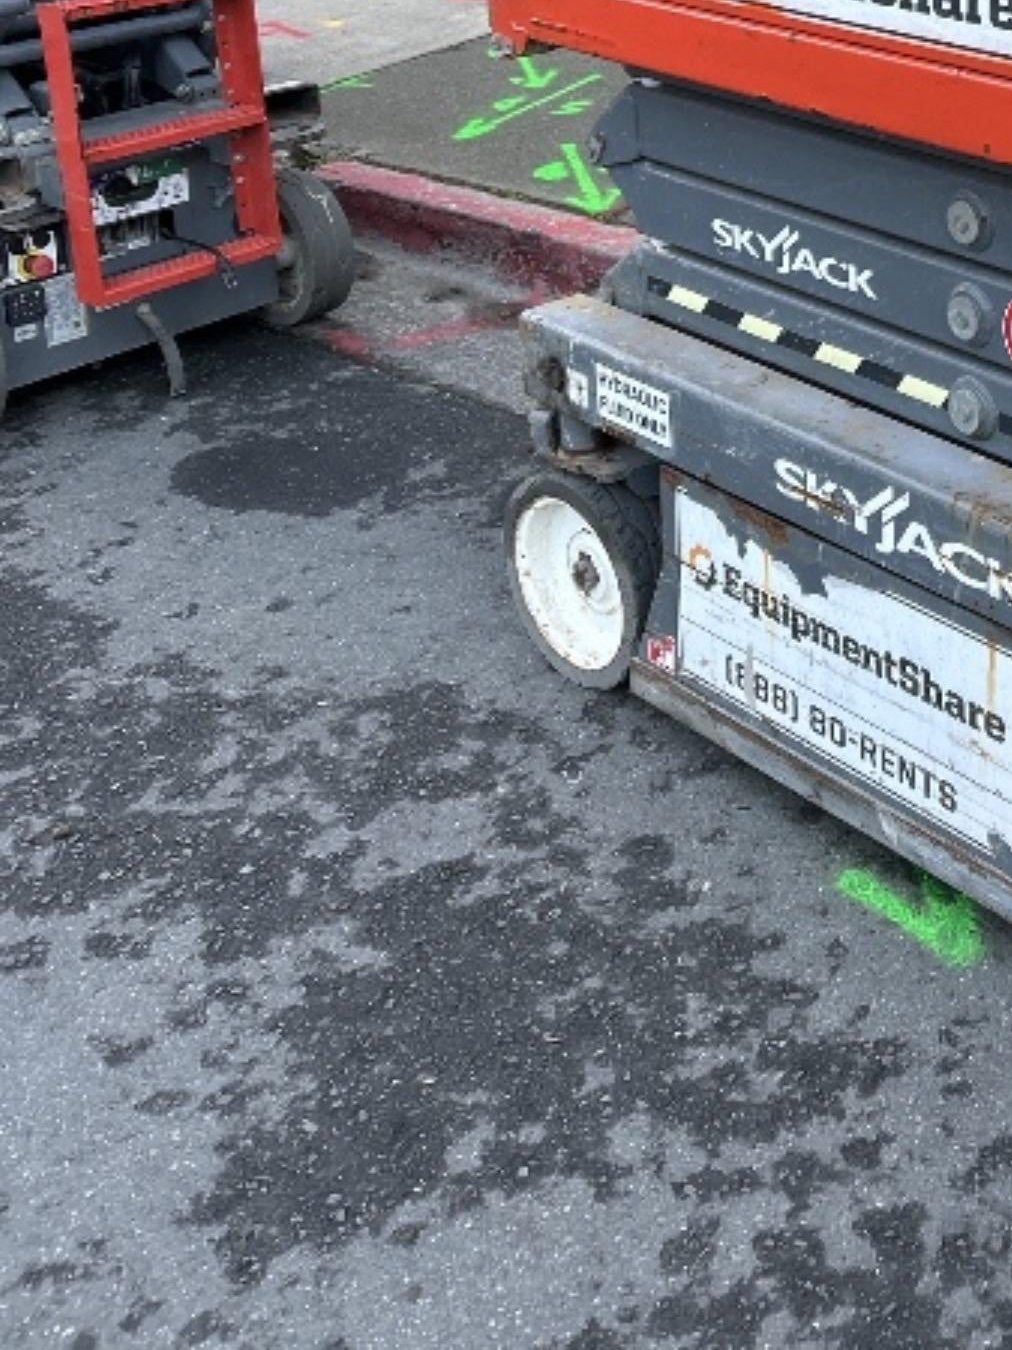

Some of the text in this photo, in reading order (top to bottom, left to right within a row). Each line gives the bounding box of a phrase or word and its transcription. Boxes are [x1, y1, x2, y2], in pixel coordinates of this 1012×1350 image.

[710, 218, 878, 301] SKYJACK
[722, 562, 1006, 743] EquipmentShare
[809, 705, 957, 813] 80-RENTS
